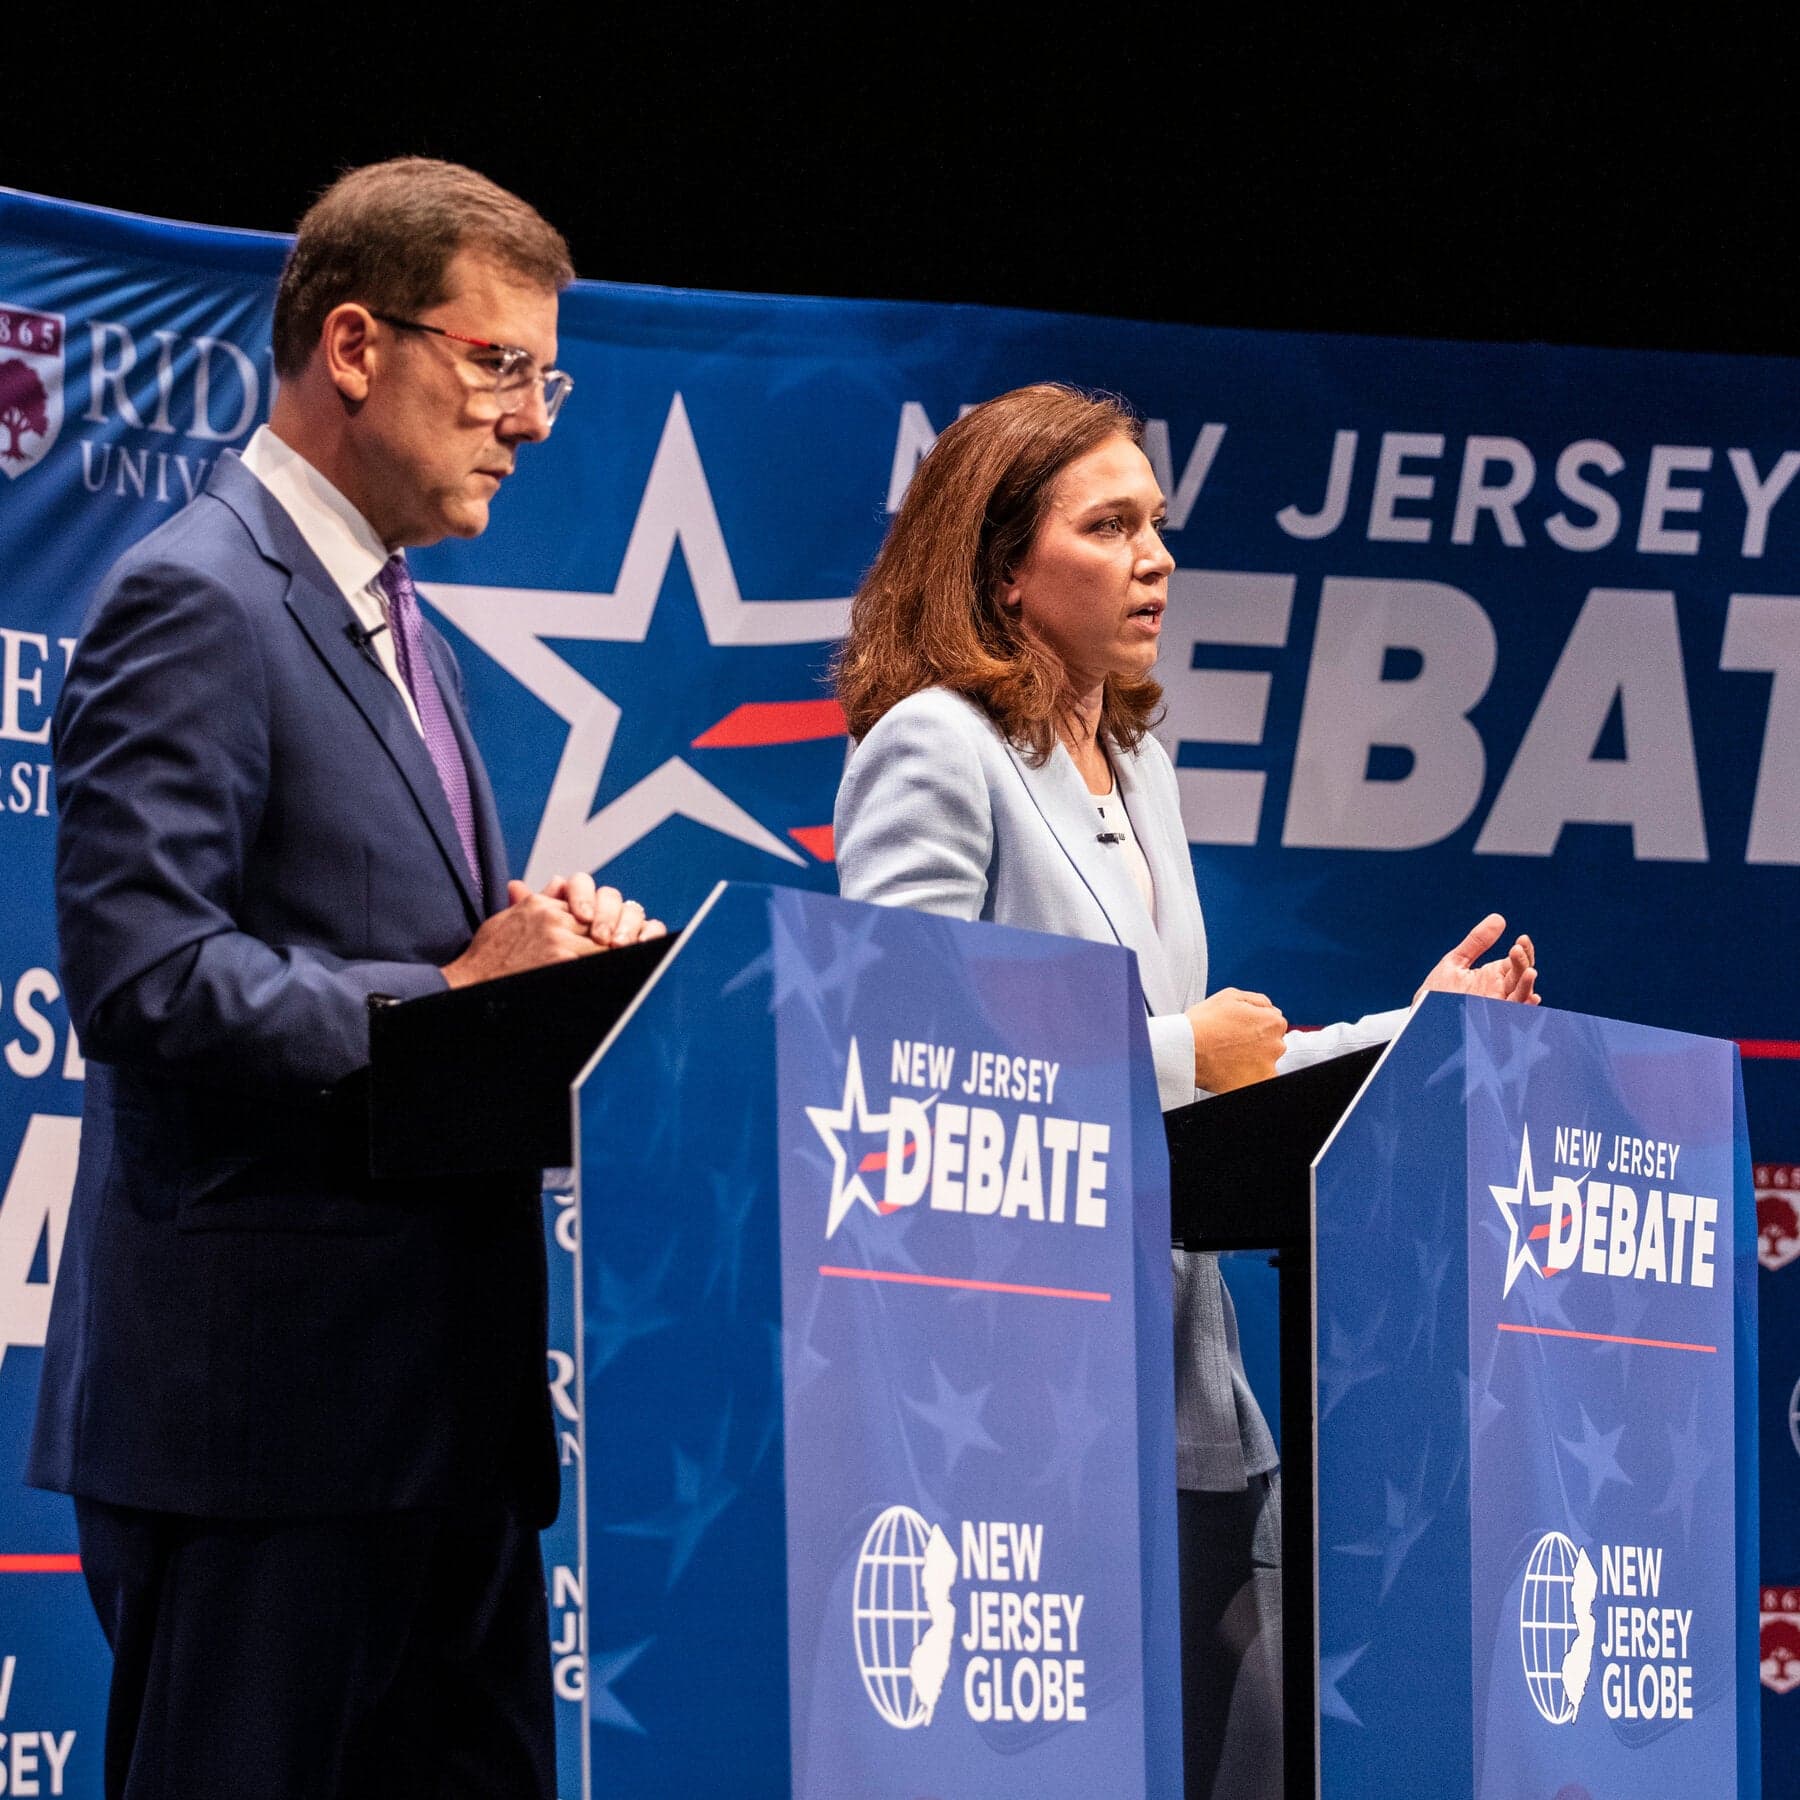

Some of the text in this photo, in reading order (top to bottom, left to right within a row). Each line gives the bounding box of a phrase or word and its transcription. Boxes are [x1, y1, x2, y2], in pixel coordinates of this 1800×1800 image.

[84, 320, 279, 441] RID
[1276, 429, 1800, 558] JERSEY
[891, 1039, 1060, 1104] NEW JERSEY
[885, 1095, 1111, 1228] DEBATE
[1554, 1126, 1681, 1181] NEW JERSEY
[1547, 1171, 1718, 1288] DEBATE
[961, 1520, 1044, 1582] NEW
[1601, 1545, 1663, 1598] NEW
[961, 1591, 1084, 1652] JERSEY
[1601, 1606, 1693, 1659] JERSEY
[963, 1656, 1087, 1723] GLOBE
[1602, 1663, 1693, 1719] GLOBE
